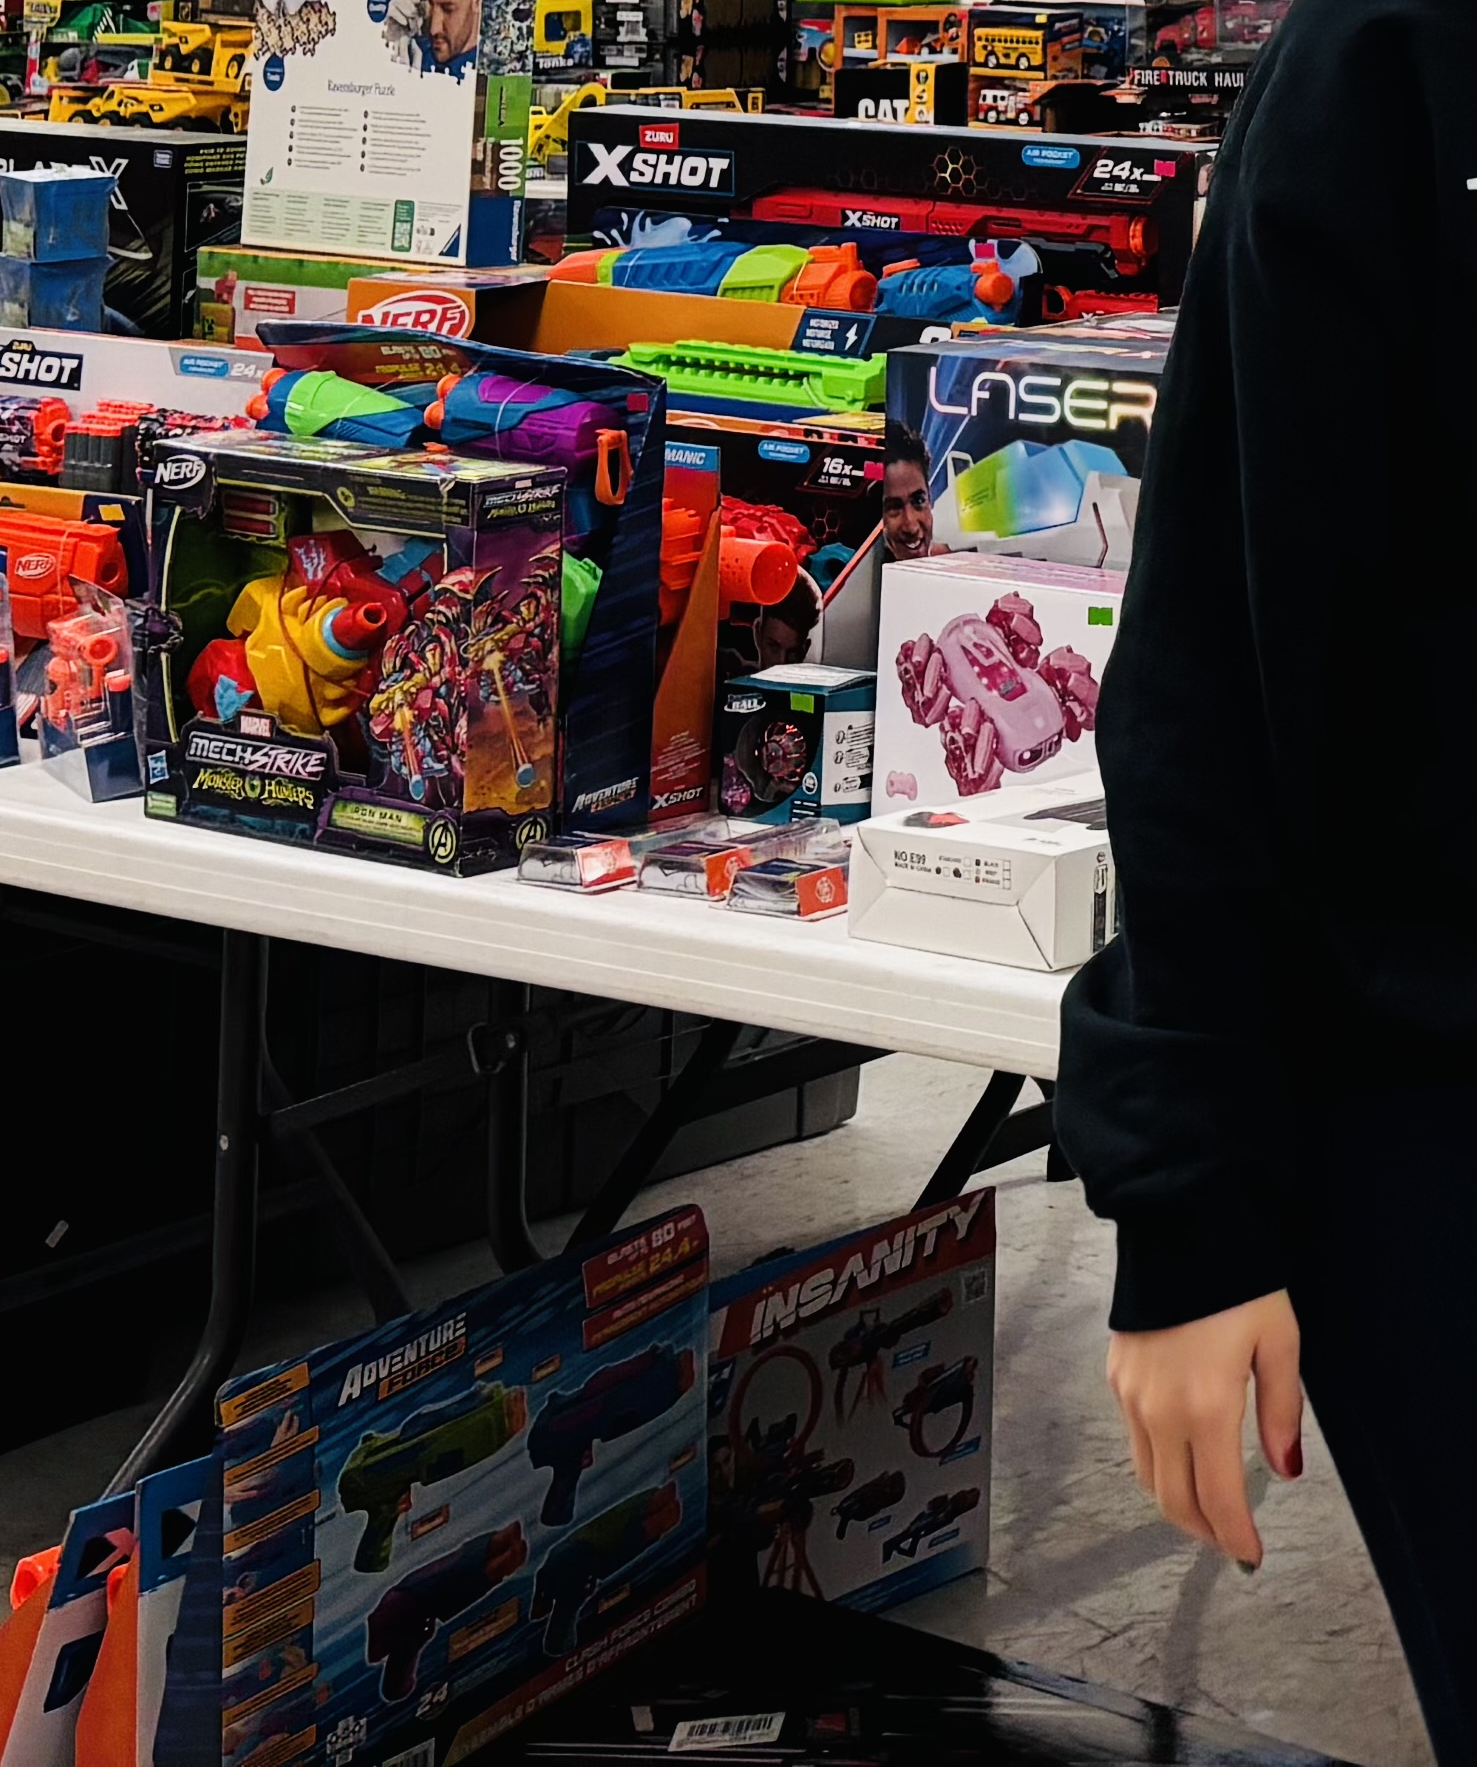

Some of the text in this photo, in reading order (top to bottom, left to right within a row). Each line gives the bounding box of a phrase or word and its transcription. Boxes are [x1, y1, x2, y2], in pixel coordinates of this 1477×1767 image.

[537, 58, 575, 71] Tonka
[1133, 68, 1208, 88] FIRE TRUCK
[858, 98, 909, 123] CAT
[644, 130, 674, 144] ZURU
[497, 136, 524, 191] 1000
[929, 364, 1157, 432] LASER
[154, 457, 204, 485] NERF
[192, 768, 315, 810] MONSTER HUNTERS
[337, 1310, 469, 1408] ADVENTURE
